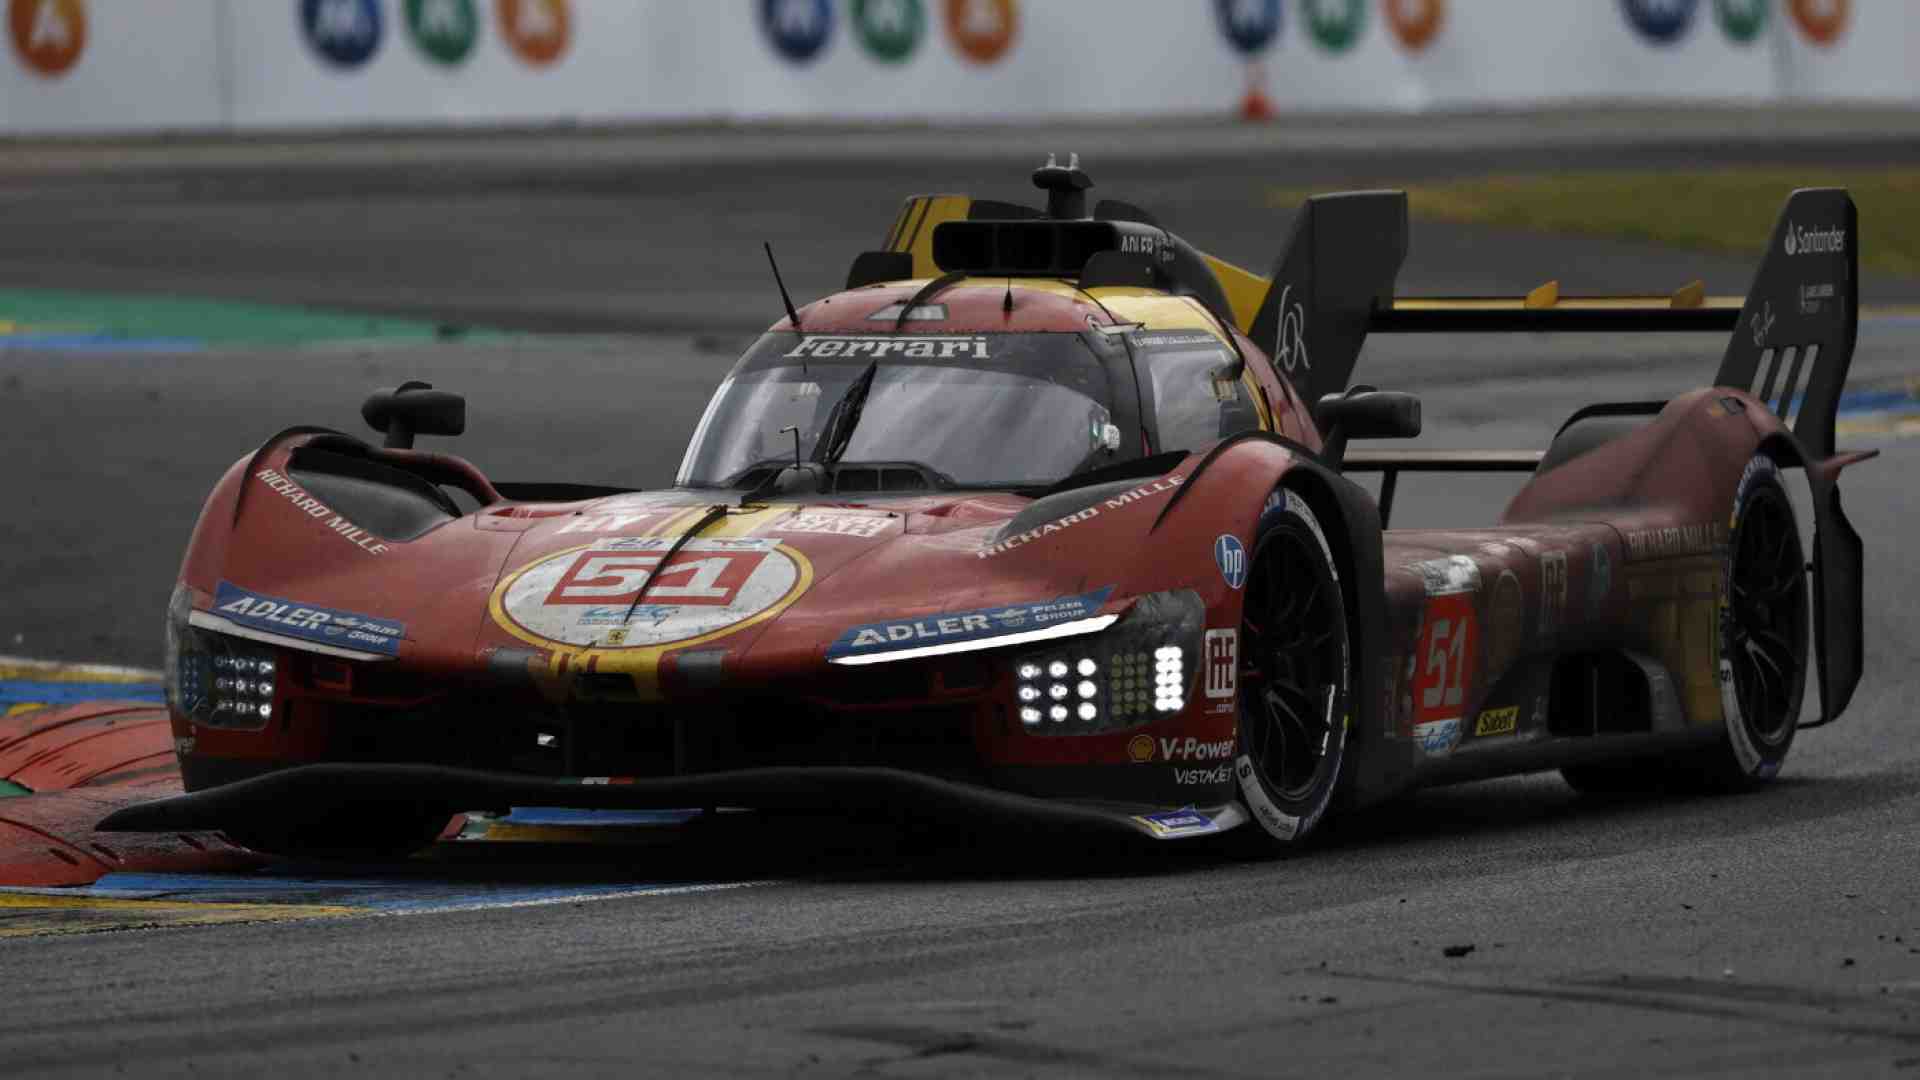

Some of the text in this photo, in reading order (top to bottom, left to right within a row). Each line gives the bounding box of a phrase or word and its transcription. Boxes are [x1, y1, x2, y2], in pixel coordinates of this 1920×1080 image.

[1797, 224, 1846, 254] Santander
[783, 335, 991, 359] Ferrari
[256, 468, 389, 555] RICHARD MILLE
[976, 474, 1186, 560] RICHARD MILLE
[560, 556, 735, 598] 51
[1221, 536, 1243, 587] hp
[220, 596, 331, 630] ADLER
[1034, 609, 1087, 622] GROUP
[851, 614, 992, 647] ADLER
[1423, 617, 1467, 709] 51
[1159, 737, 1235, 760] V-Power
